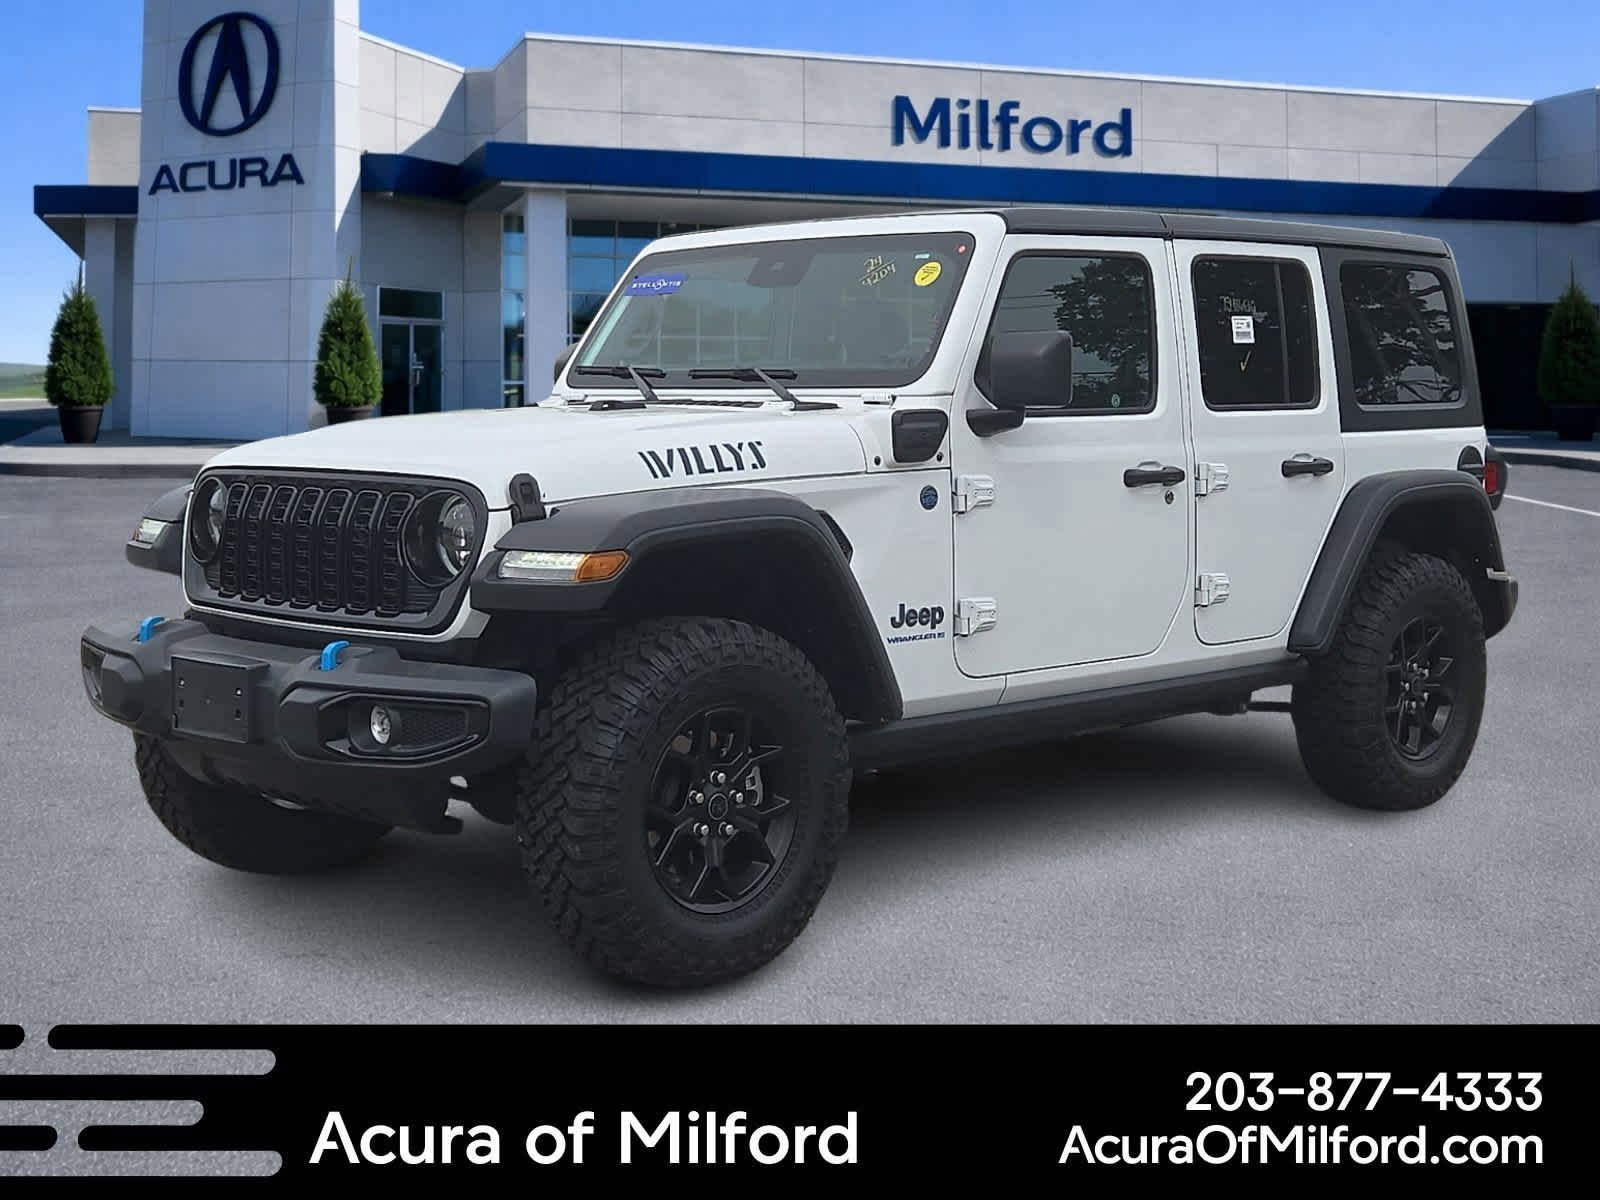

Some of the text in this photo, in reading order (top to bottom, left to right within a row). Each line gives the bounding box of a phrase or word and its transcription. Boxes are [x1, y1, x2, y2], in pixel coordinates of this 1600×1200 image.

[891, 95, 1133, 158] Milford
[148, 153, 305, 195] ACURA
[637, 440, 767, 479] WILLYS
[890, 603, 945, 630] Jeep
[886, 632, 937, 644] WRANGLER
